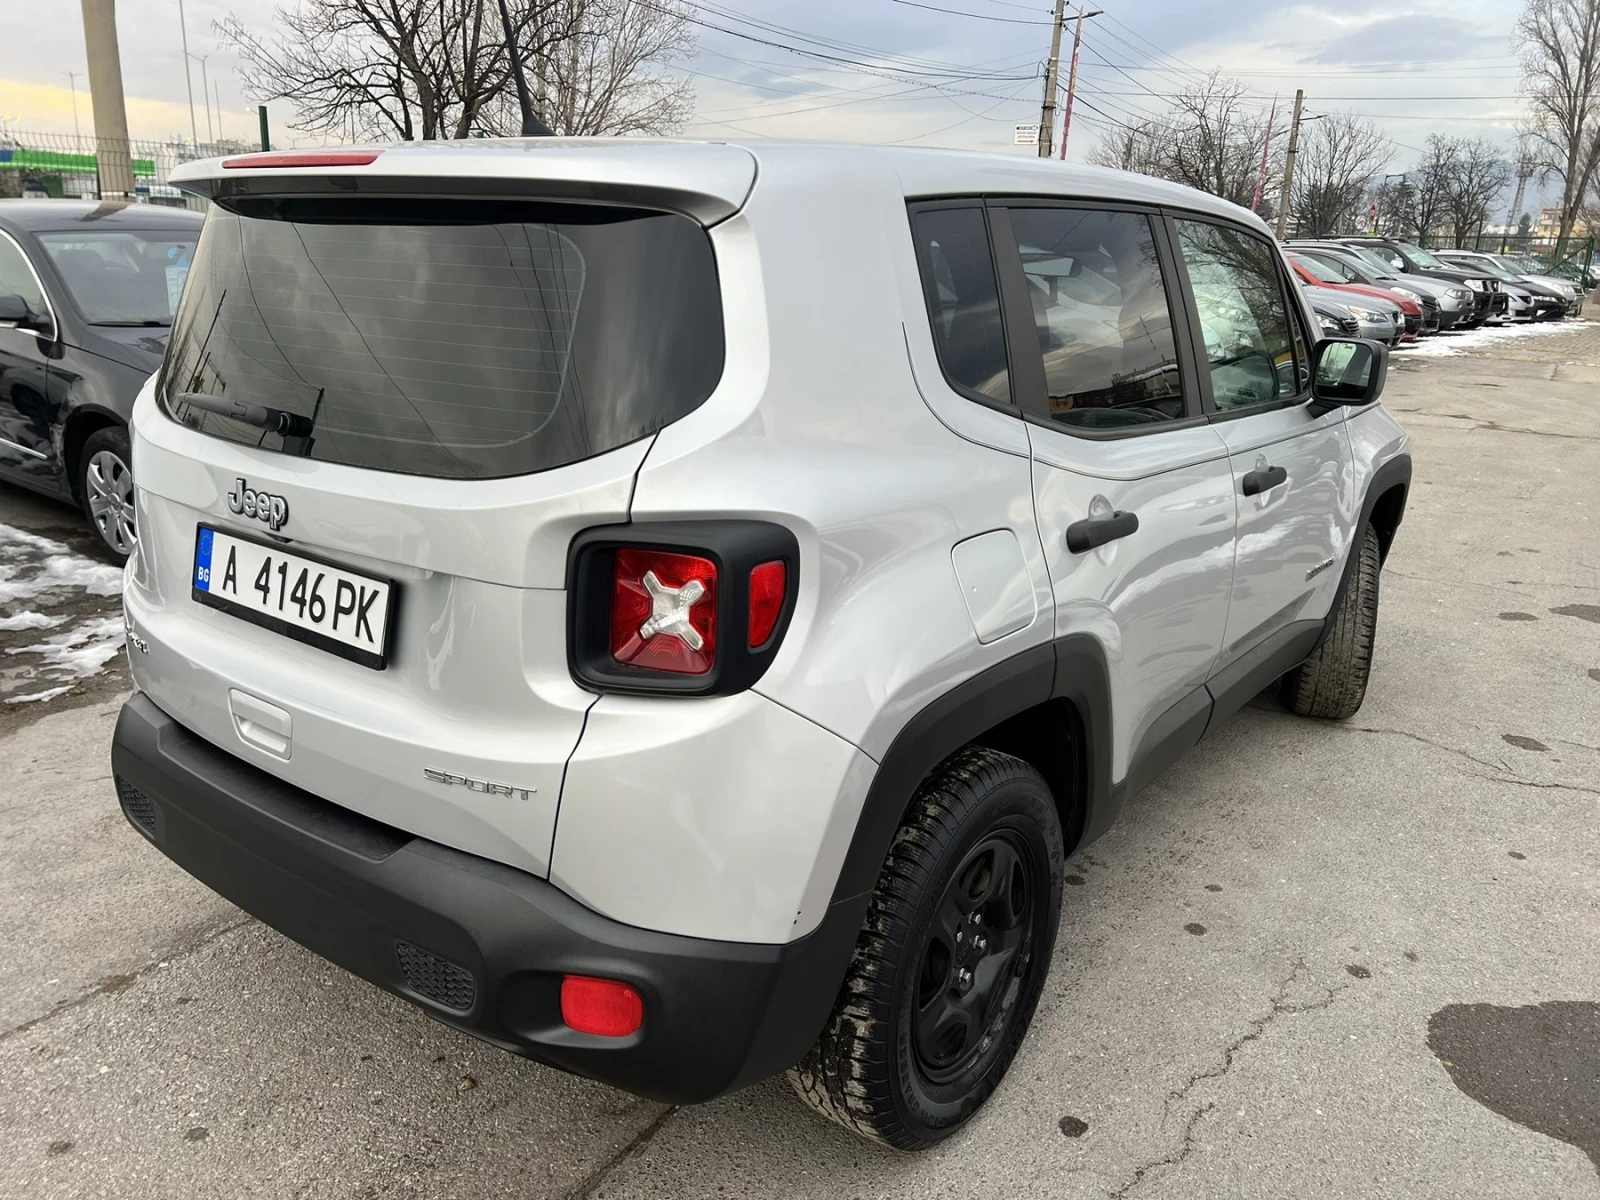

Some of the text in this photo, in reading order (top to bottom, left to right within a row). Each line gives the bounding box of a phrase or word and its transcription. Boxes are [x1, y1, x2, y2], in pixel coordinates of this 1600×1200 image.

[228, 478, 289, 532] Jeep
[198, 566, 210, 582] BG
[222, 545, 380, 643] A 4146 PK
[424, 766, 537, 801] SPORT
